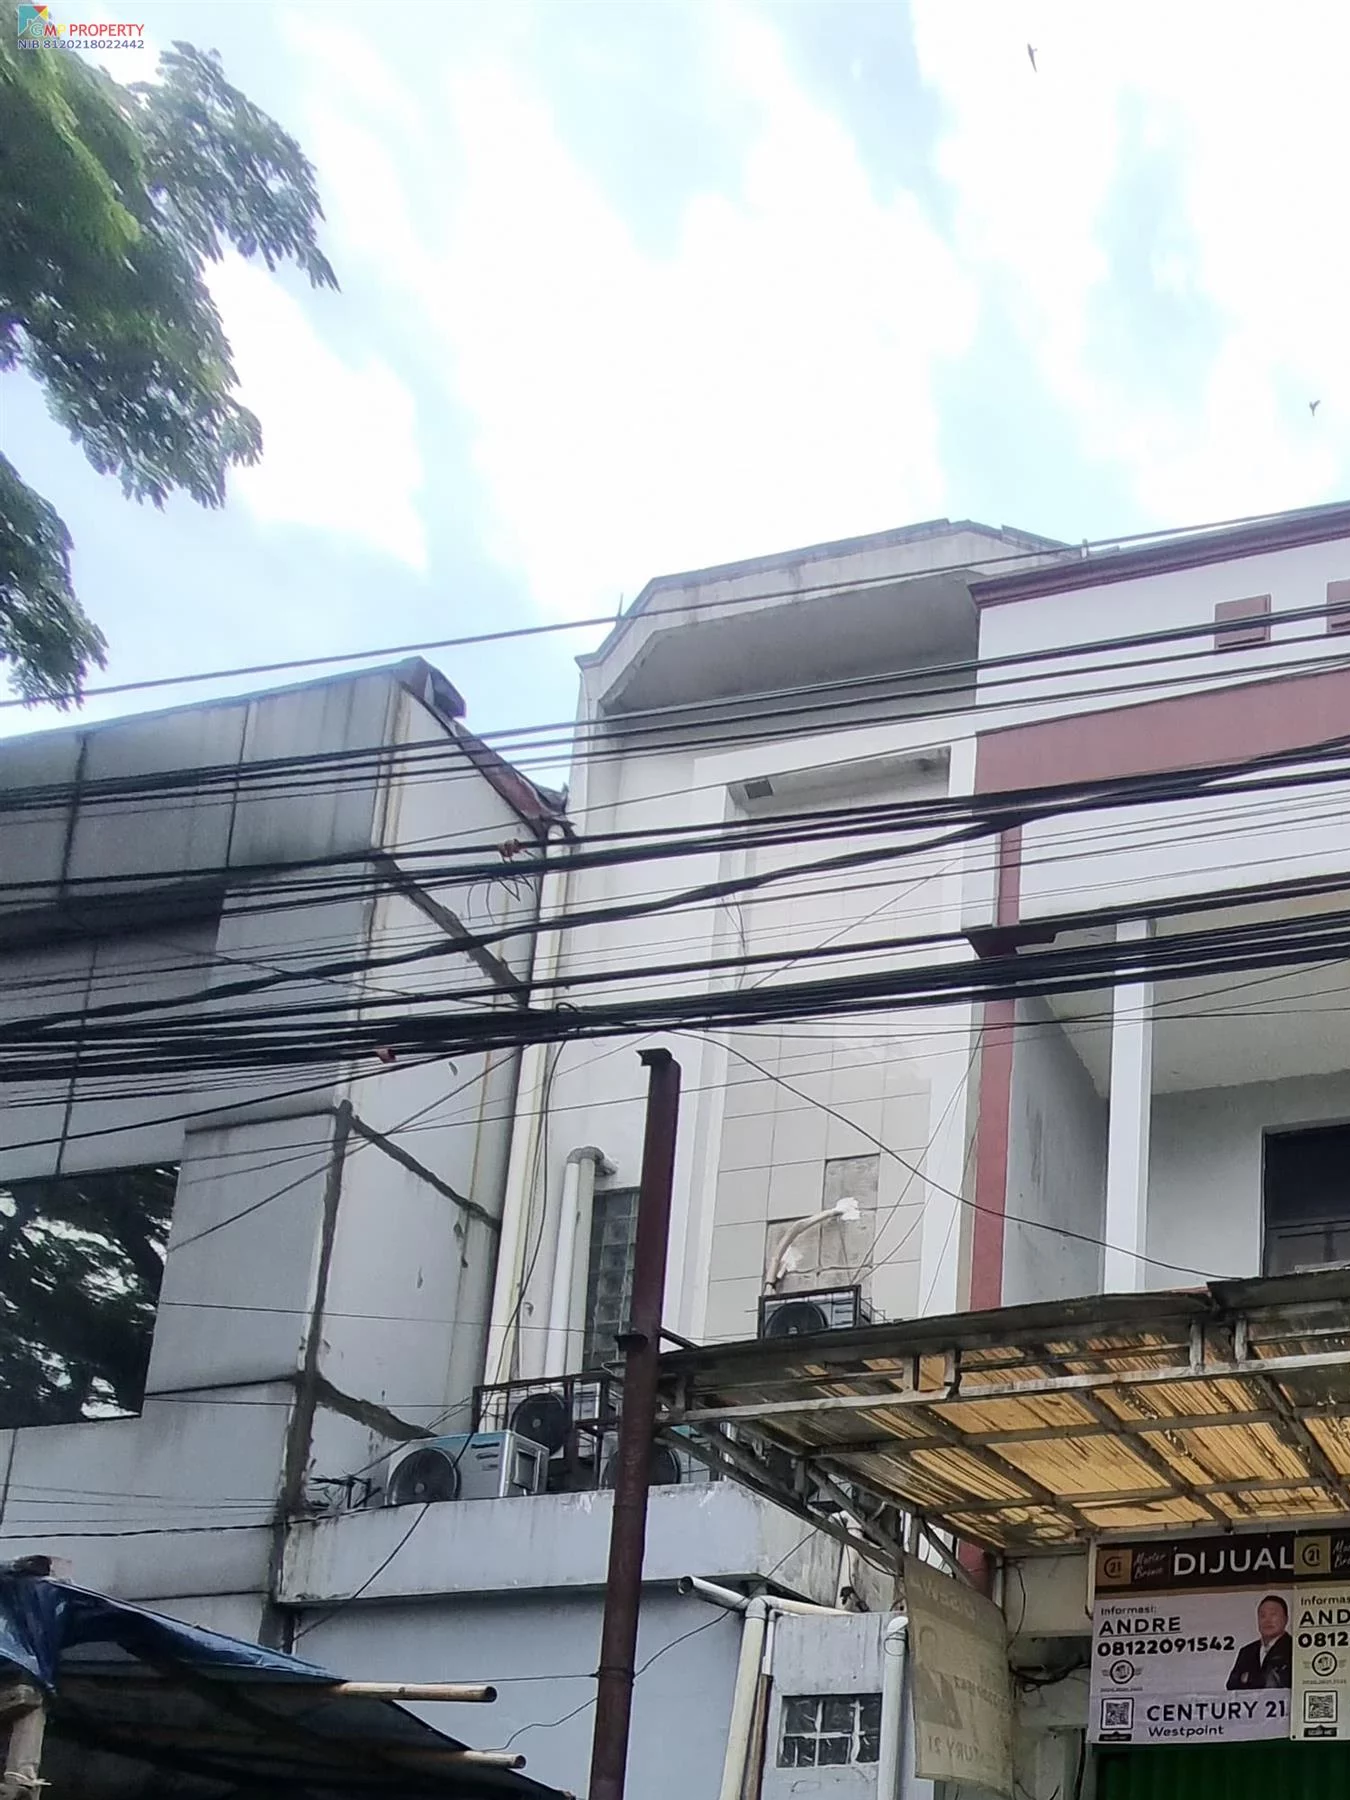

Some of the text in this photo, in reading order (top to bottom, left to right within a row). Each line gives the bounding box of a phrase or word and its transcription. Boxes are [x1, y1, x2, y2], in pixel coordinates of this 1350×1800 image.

[1173, 1546, 1294, 1576] DIJUAL
[1101, 1606, 1157, 1616] Informasi:
[1100, 1616, 1181, 1636] ANDRE
[1098, 1636, 1235, 1656] 08122091542
[1147, 1700, 1285, 1721] CENTURY 21
[1148, 1724, 1224, 1738] Westpoint
